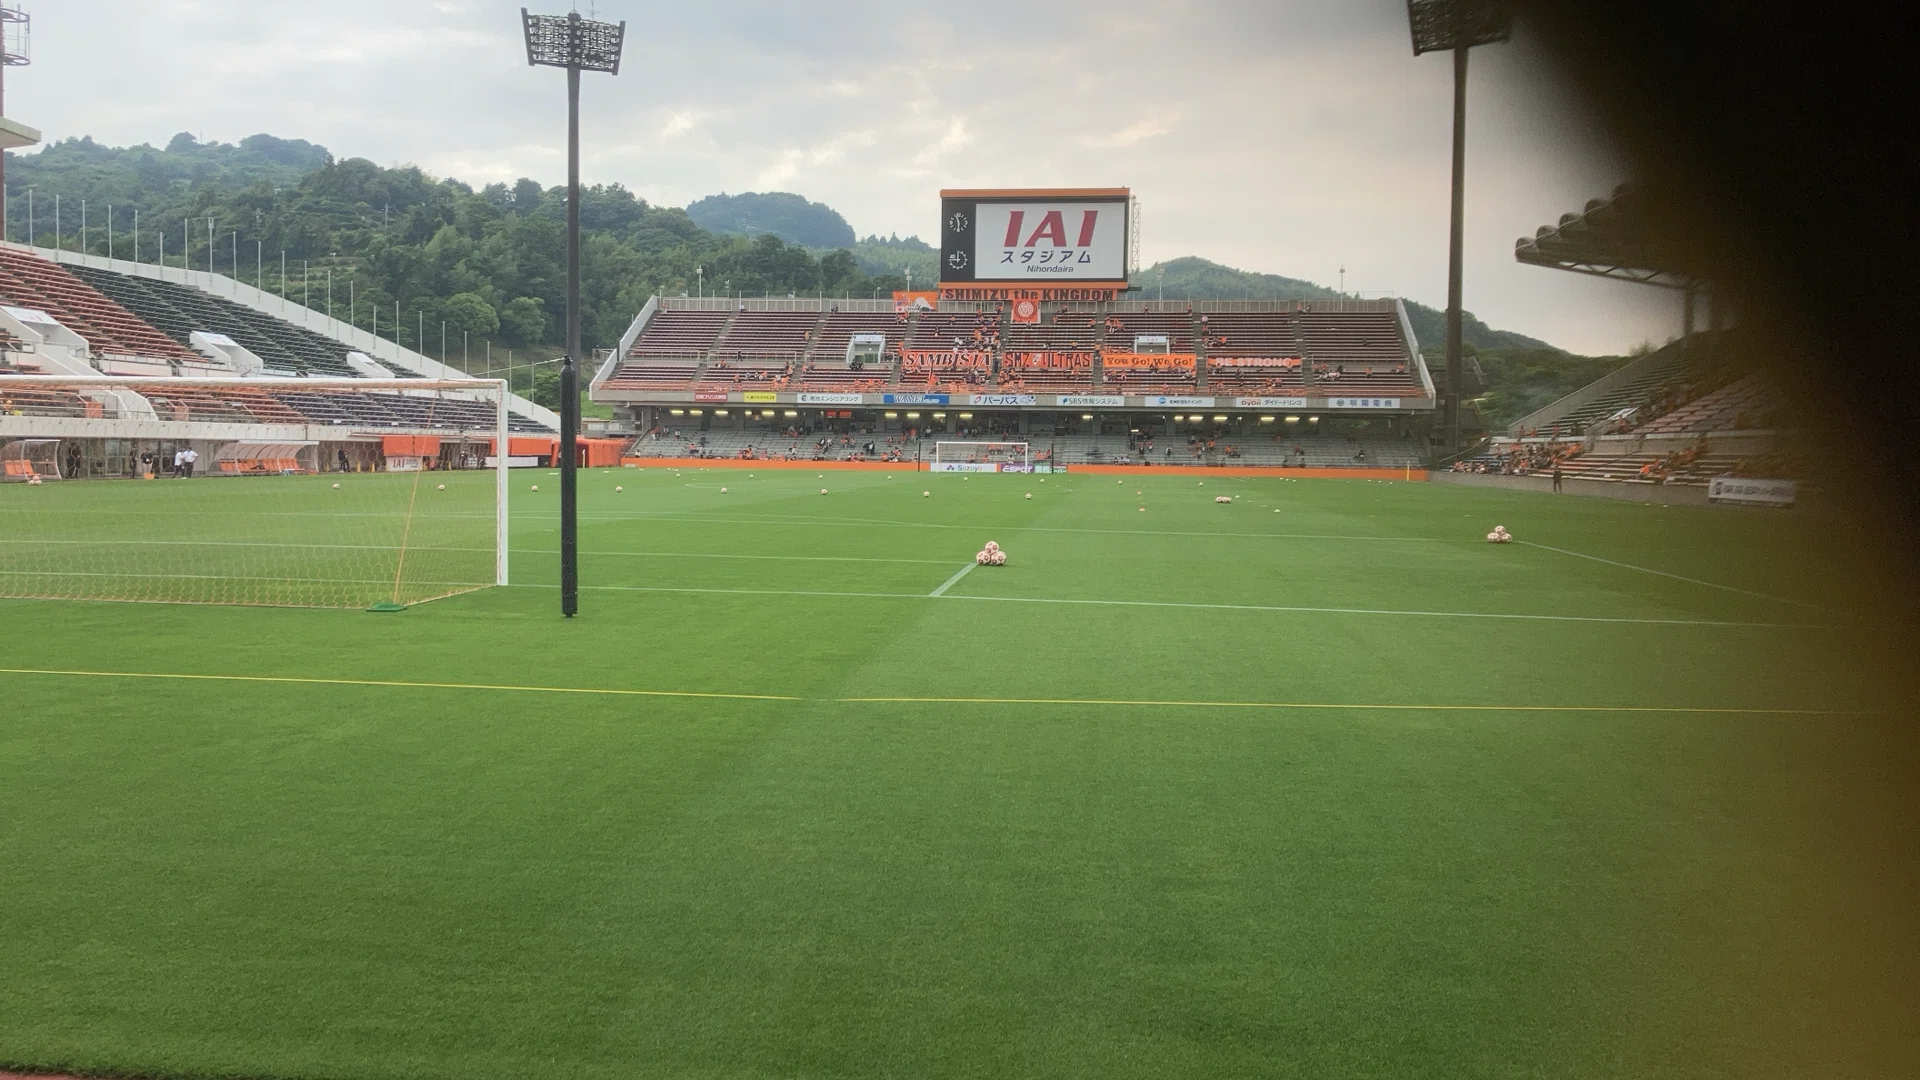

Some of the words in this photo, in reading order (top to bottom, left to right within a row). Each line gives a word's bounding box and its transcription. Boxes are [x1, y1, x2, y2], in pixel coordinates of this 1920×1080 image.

[1004, 210, 1099, 247] IAI
[1000, 250, 1091, 264] スタジアム
[1026, 265, 1074, 273] Nihondaira
[945, 289, 1009, 300] SHIMIZU
[1013, 289, 1039, 300] the
[1043, 289, 1114, 301] KINGDOM
[904, 352, 991, 367] SAMBISTA
[1107, 356, 1129, 365] You
[1132, 357, 1150, 365] Go!
[1152, 357, 1170, 366] We
[1173, 357, 1193, 366] Go!
[1215, 357, 1237, 367] BE
[1239, 357, 1292, 367] STRONG
[983, 396, 1018, 405] パーパス
[1068, 397, 1118, 405] SBS情報システム
[957, 465, 983, 473] Suzuyo
